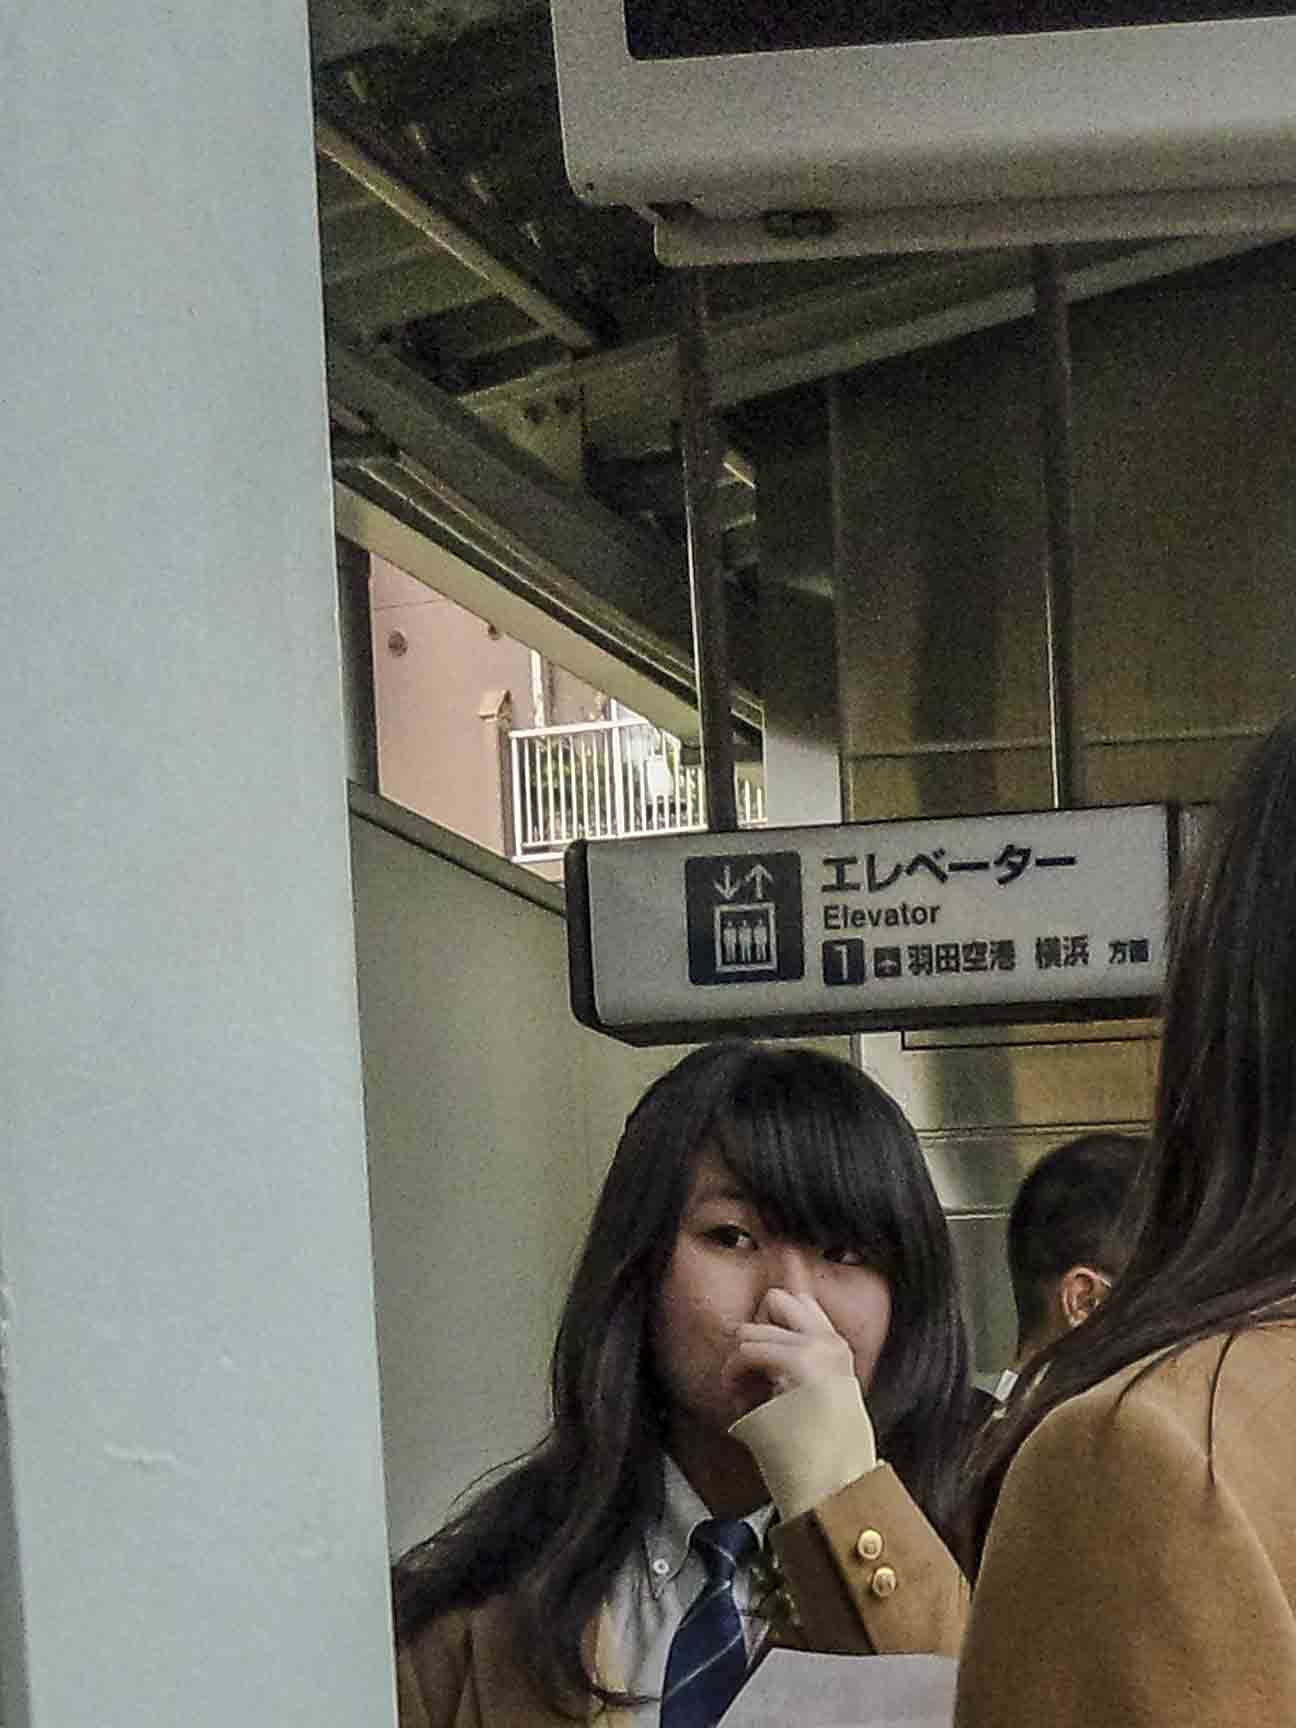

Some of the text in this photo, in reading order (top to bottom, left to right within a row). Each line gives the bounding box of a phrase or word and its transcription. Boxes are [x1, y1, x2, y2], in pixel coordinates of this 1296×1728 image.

[821, 843, 1077, 893] エレベーター
[823, 902, 941, 930] Elevator
[906, 940, 1017, 976] 羽田空港
[1034, 935, 1090, 970] 横浜
[1107, 938, 1150, 964] 方面
